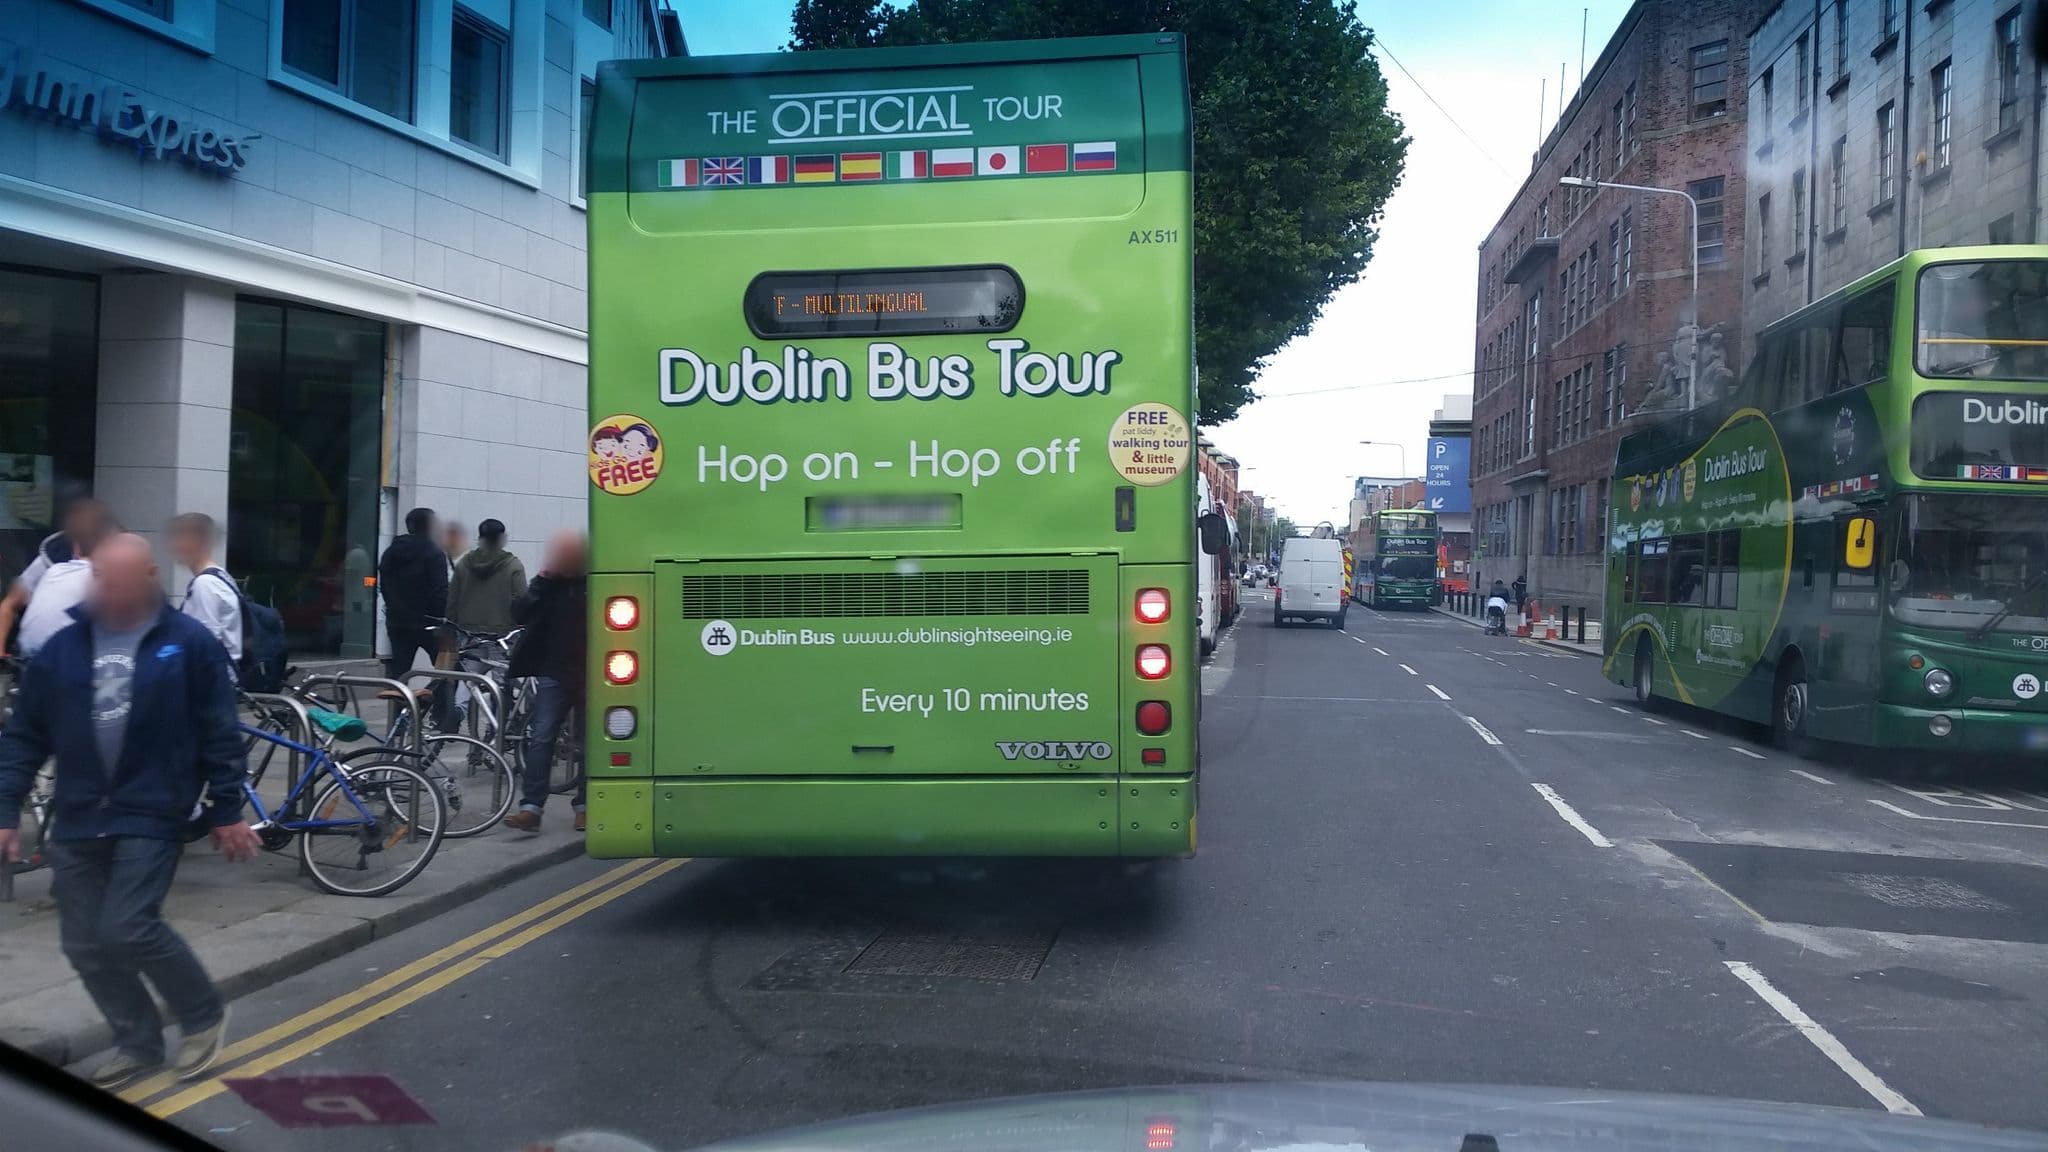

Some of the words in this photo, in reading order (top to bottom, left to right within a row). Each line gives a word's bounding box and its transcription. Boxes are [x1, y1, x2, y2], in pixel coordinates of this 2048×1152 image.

[706, 109, 757, 135] THE
[772, 93, 970, 137] OFFICIAL
[982, 94, 1063, 122] TOUR
[111, 87, 262, 171] Express
[804, 292, 928, 314] MULTILINGUAL
[659, 344, 850, 403] Dublin
[868, 341, 975, 400] Bus
[986, 338, 1123, 397] Tour
[1128, 411, 1169, 425] FREE
[1112, 437, 1160, 451] walking
[1163, 438, 1190, 448] tour
[1435, 444, 1447, 459] P
[698, 444, 788, 492] Hop
[802, 448, 858, 482] on
[873, 460, 894, 468] -
[909, 438, 1001, 488] Hop
[1015, 437, 1081, 477] off
[1132, 450, 1144, 463] &
[1147, 453, 1175, 464] little
[1704, 455, 1730, 482] Dublin
[1731, 450, 1747, 477] Bus
[1748, 445, 1767, 472] Tour
[597, 456, 658, 490] FREE
[1125, 465, 1177, 475] museum
[740, 629, 797, 646] Dublin
[800, 629, 835, 645] Bus
[842, 626, 1073, 648] www.dublinsightseeing.ie
[2012, 638, 2028, 647] THE
[861, 688, 934, 718] Every
[942, 687, 971, 712] 10
[980, 686, 1089, 712] minutes
[996, 741, 1113, 760] VOLVO
